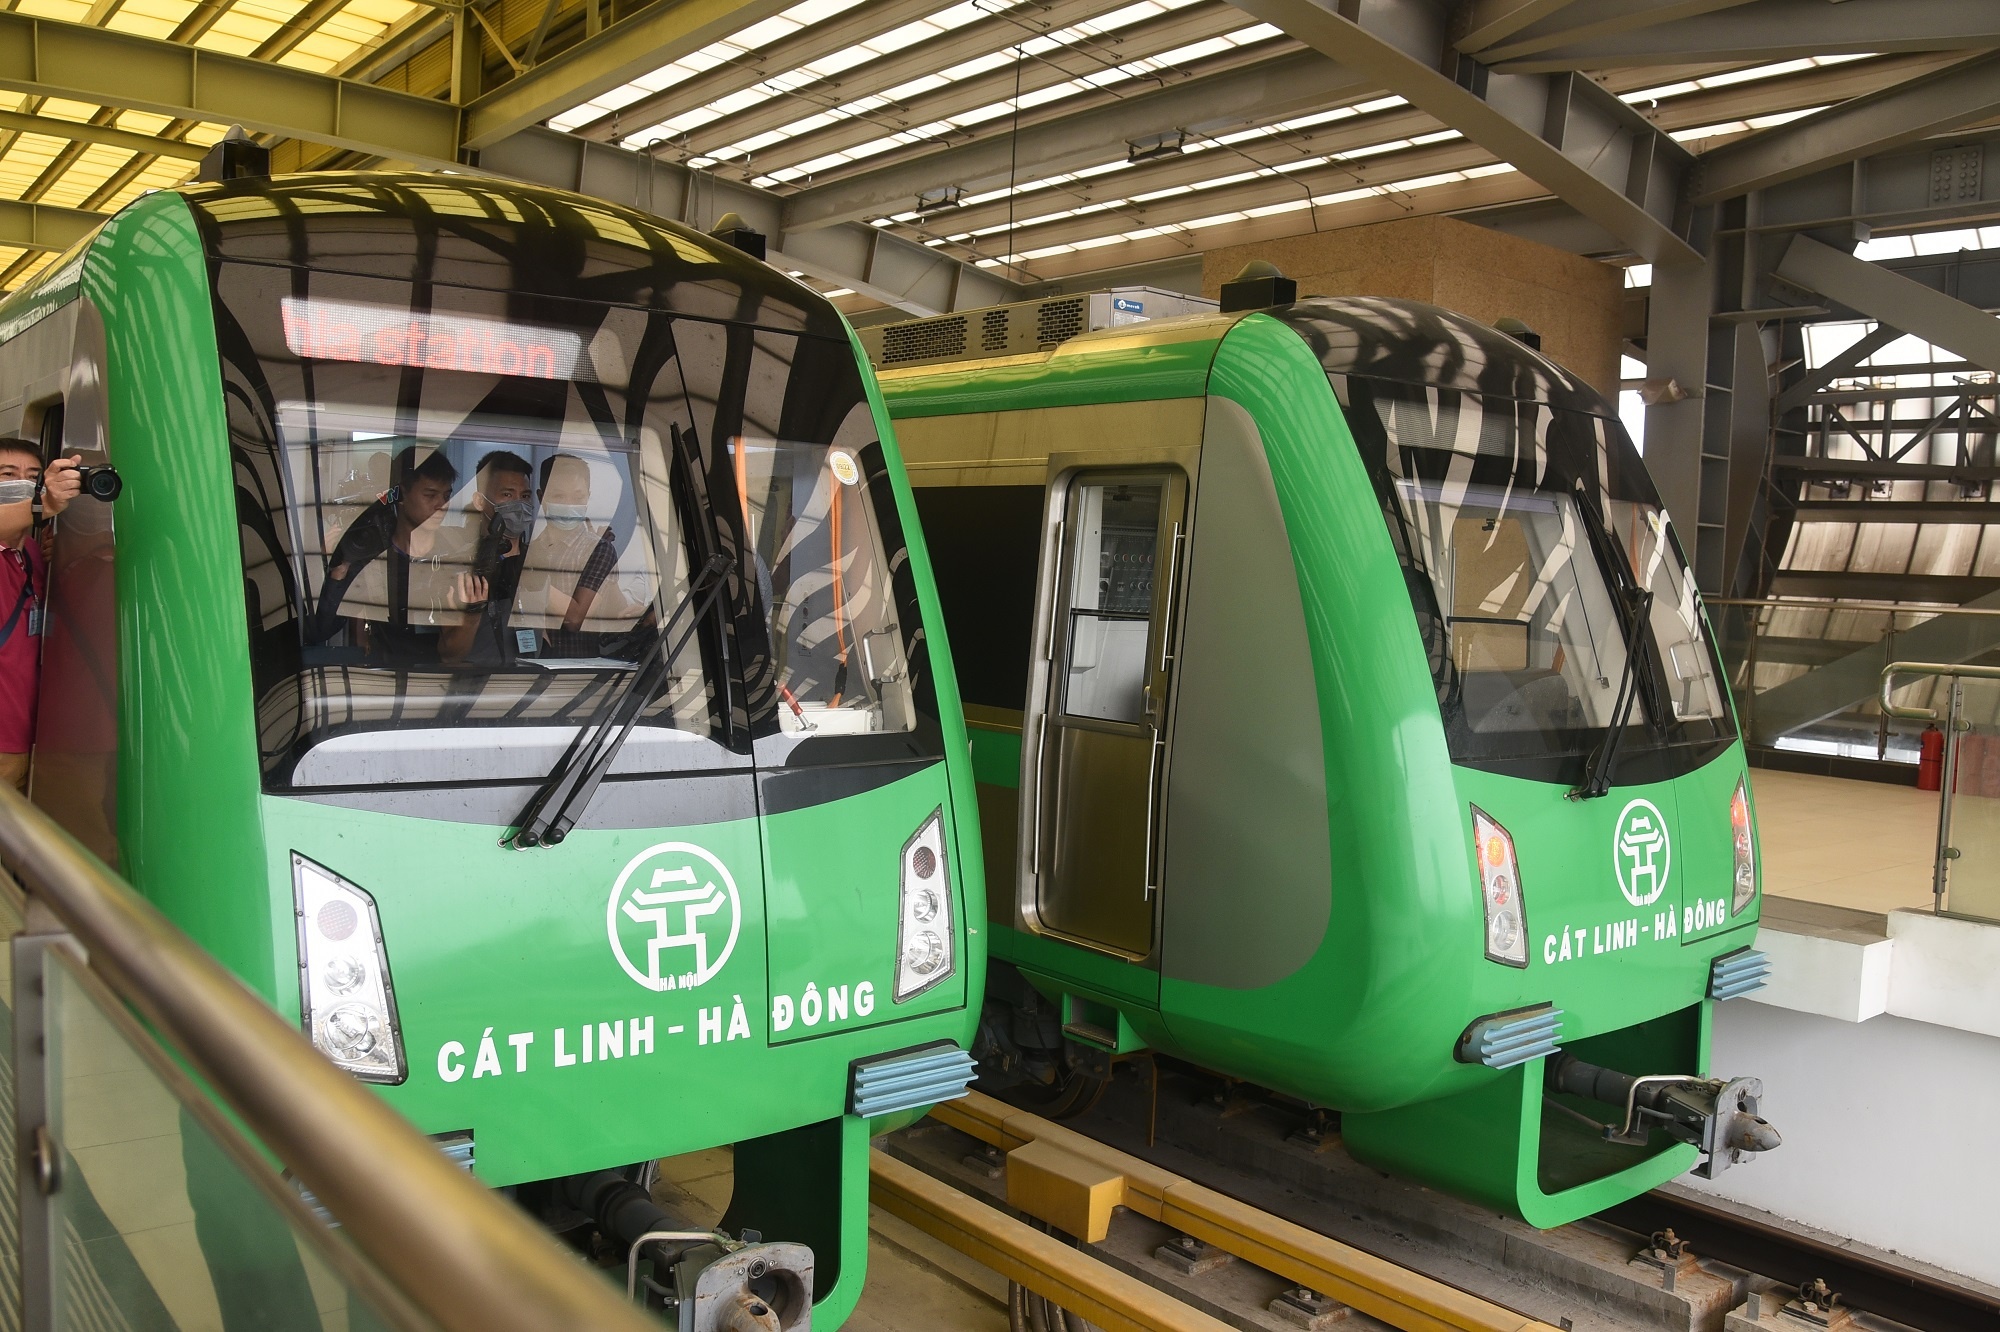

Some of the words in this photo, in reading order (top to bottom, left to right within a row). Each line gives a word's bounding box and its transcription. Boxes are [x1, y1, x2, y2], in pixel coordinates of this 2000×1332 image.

[373, 319, 557, 380] station
[376, 485, 400, 506] VTV
[1543, 925, 1587, 965] CÁT
[1593, 919, 1638, 955] LINH
[1654, 904, 1677, 941] HÀ
[1683, 898, 1726, 934] ĐÔNG
[660, 973, 677, 991] HÀ
[678, 971, 698, 991] NỘI
[437, 1027, 534, 1083] CÁT
[553, 1015, 654, 1068] LINH
[698, 994, 752, 1045] HÀ
[772, 981, 875, 1032] ĐÔNG
